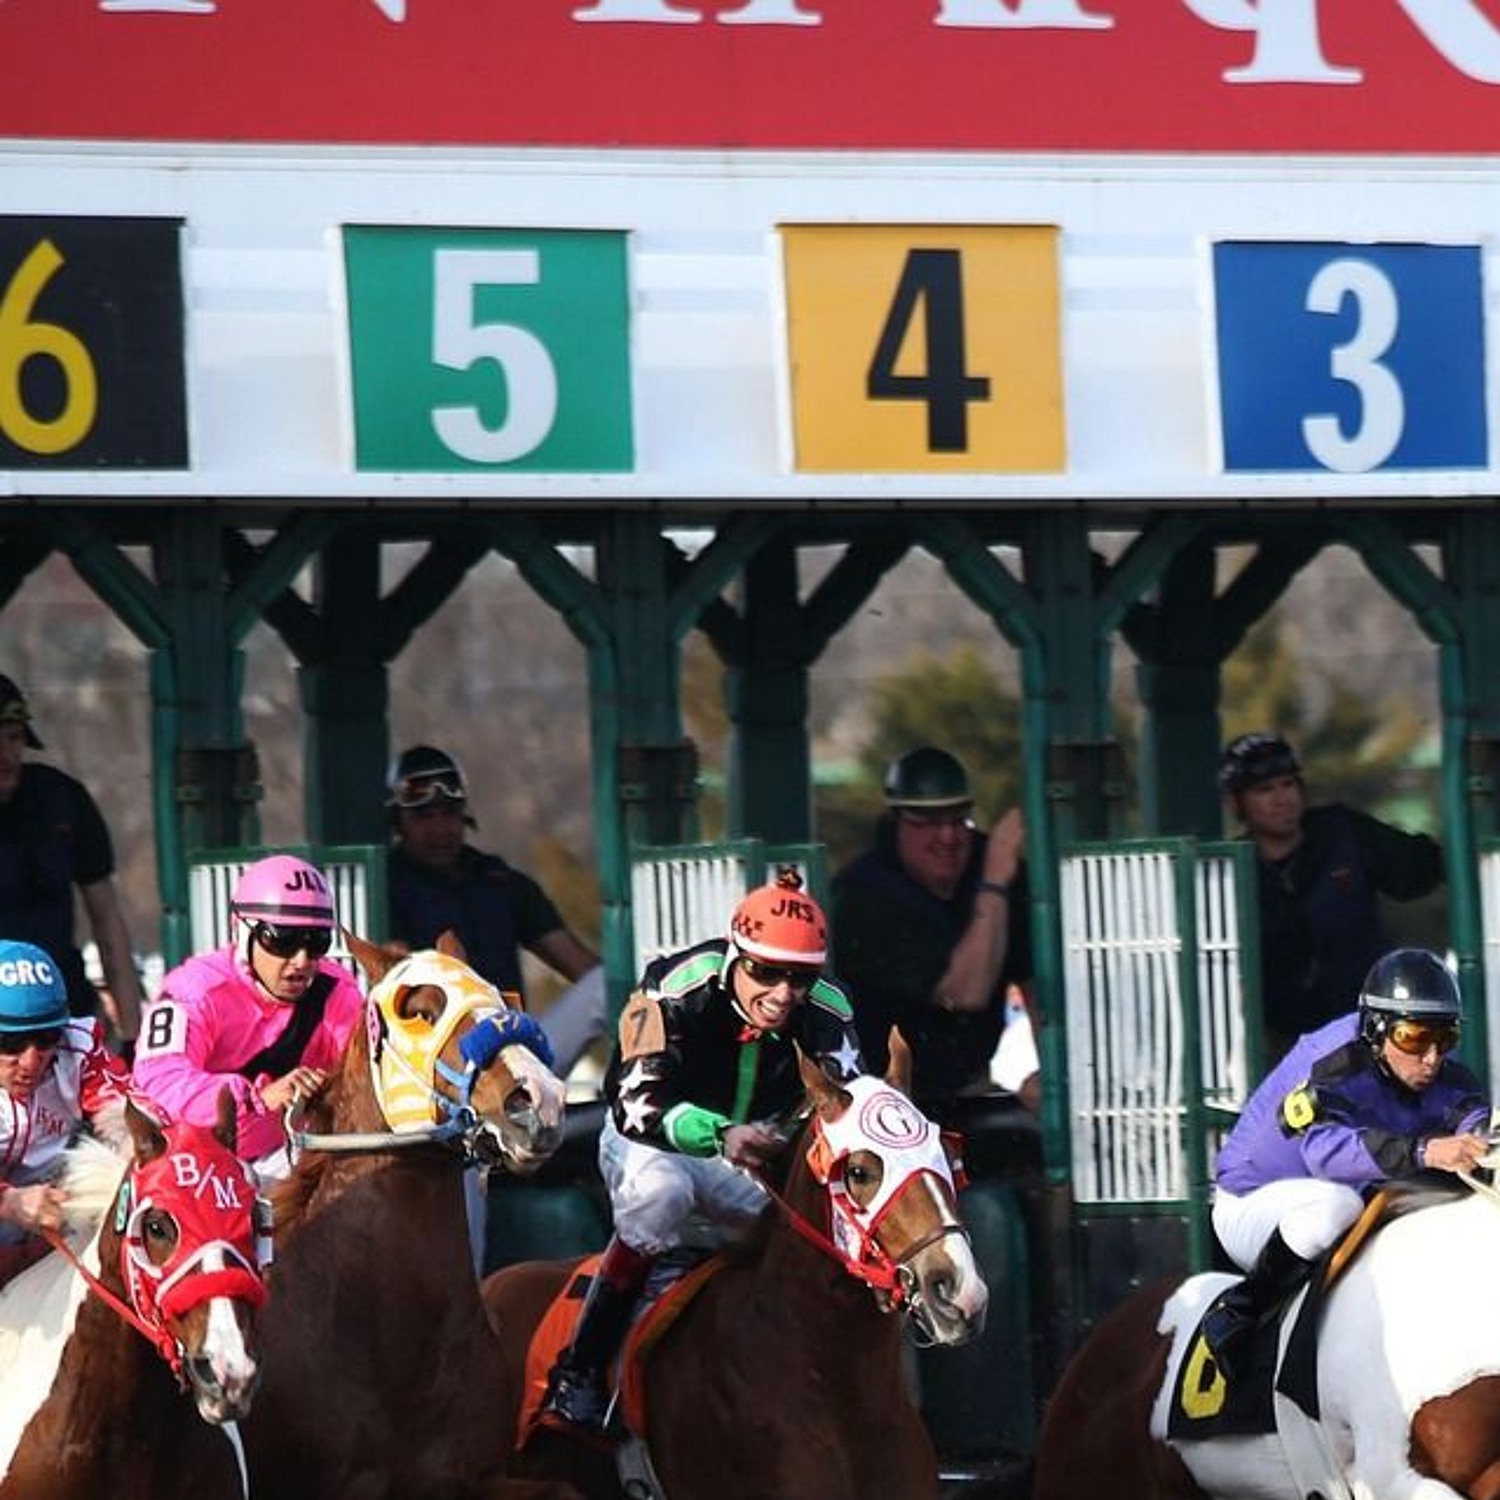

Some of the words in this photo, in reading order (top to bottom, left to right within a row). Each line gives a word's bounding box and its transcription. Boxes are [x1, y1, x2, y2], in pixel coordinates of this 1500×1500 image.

[0, 239, 97, 454] 6
[431, 248, 558, 463] 5
[867, 248, 990, 453] 4
[1302, 257, 1405, 472] 3
[770, 899, 815, 924] JRS
[0, 960, 53, 986] GRC
[148, 1007, 174, 1049] 8
[630, 1007, 648, 1048] 7
[170, 1151, 243, 1210] B/M
